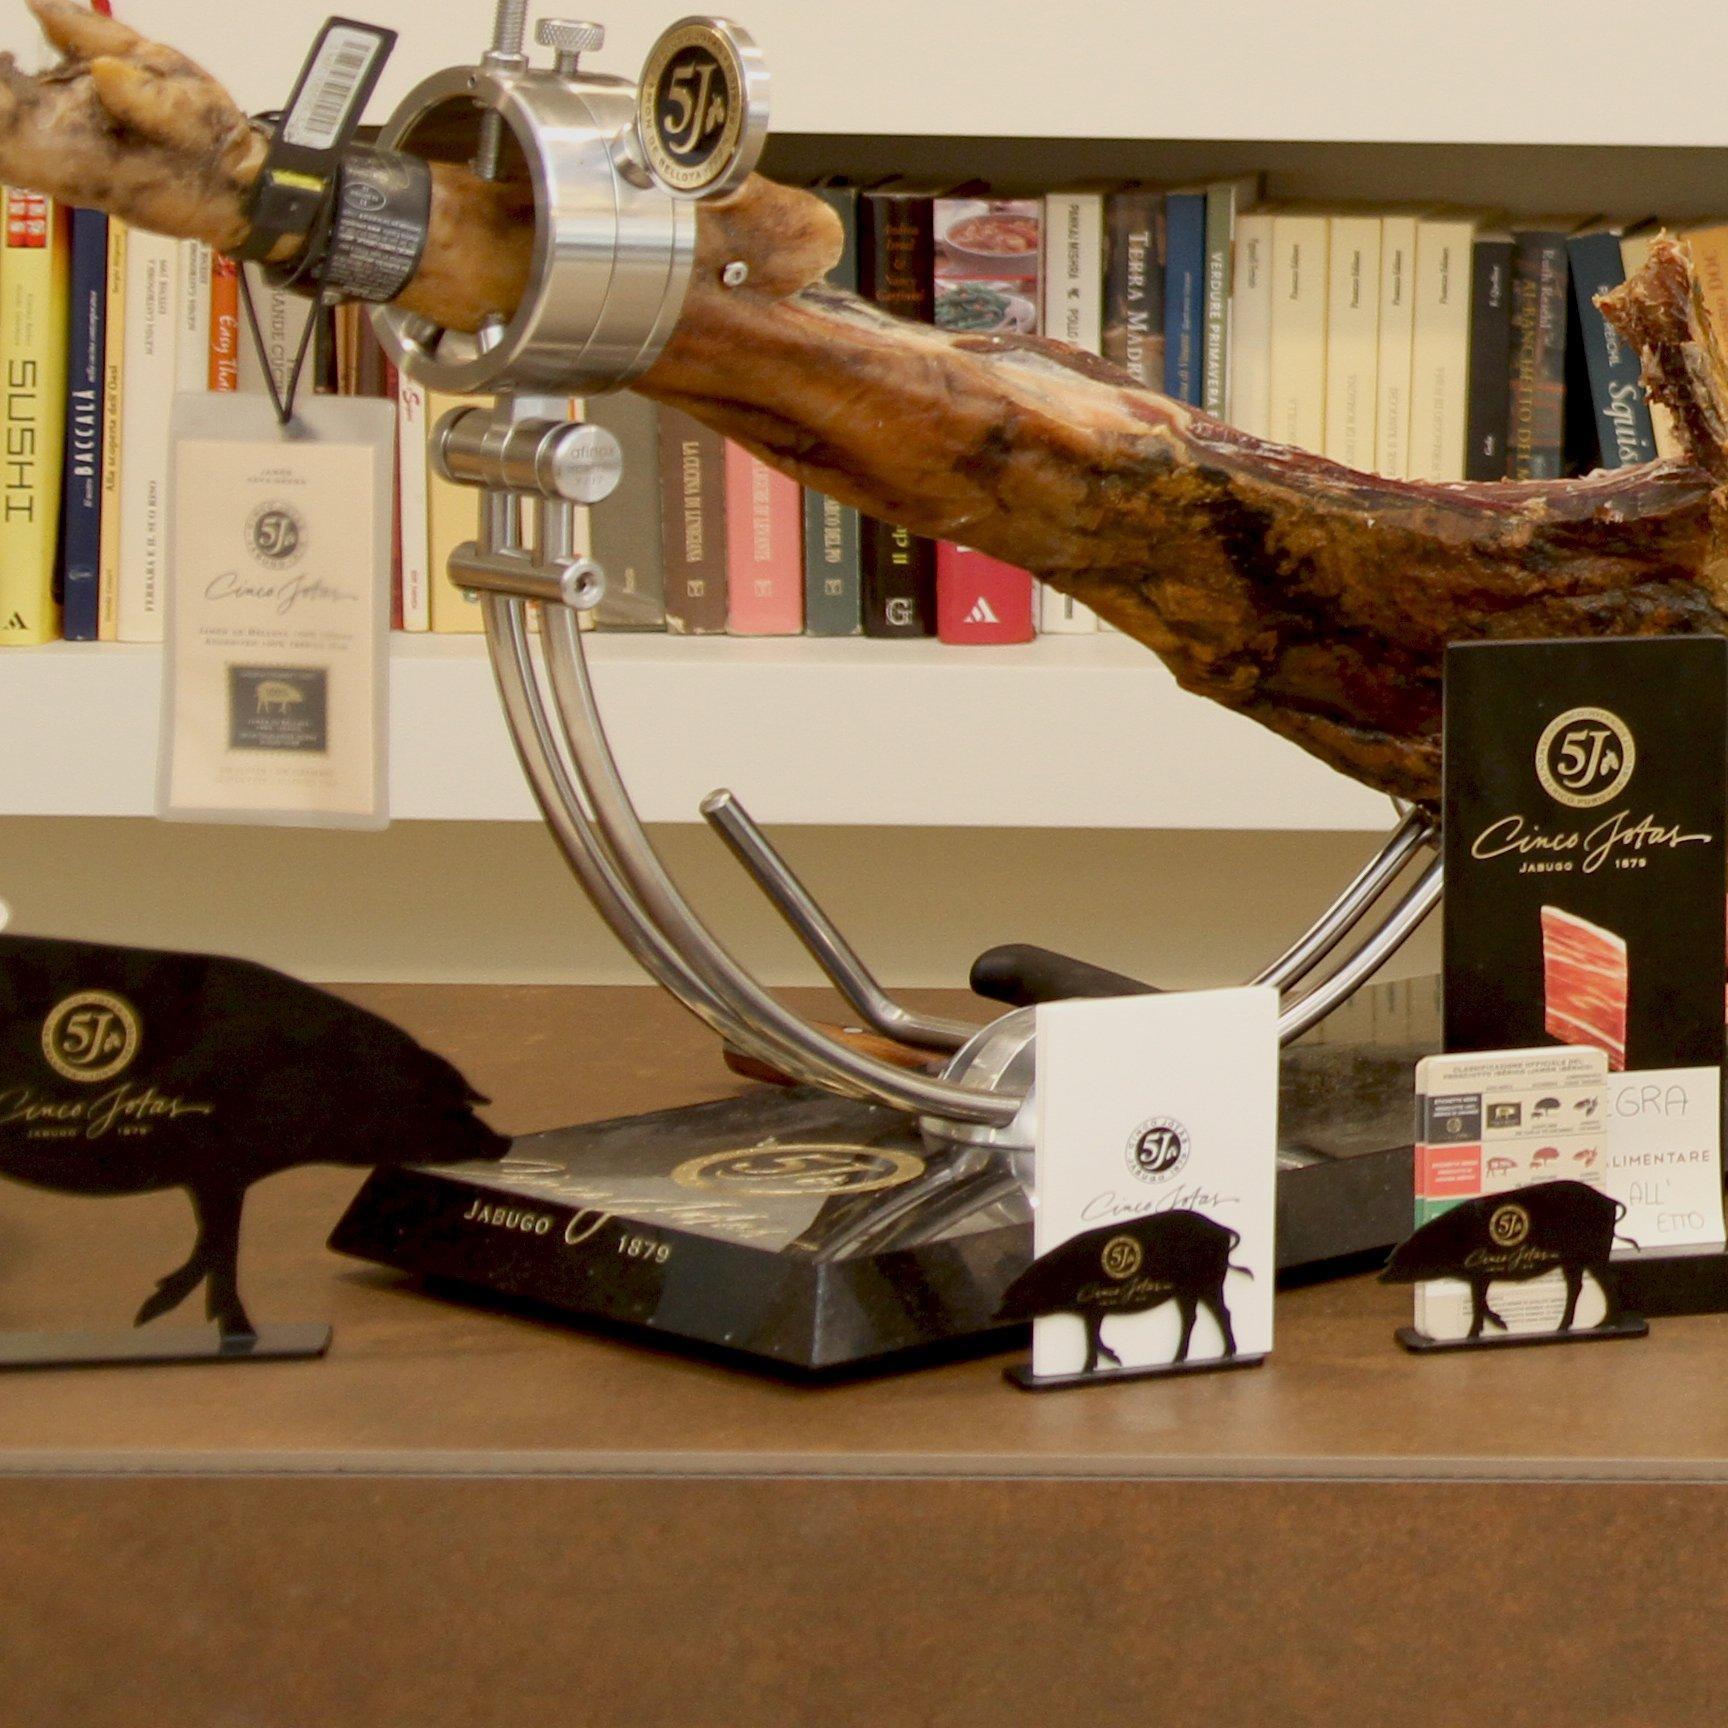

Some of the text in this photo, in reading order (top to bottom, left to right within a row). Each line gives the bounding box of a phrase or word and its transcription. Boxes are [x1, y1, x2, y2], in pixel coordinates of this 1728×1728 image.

[1126, 228, 1151, 302] TERRA
[211, 314, 235, 355] Easy
[1206, 250, 1224, 405] VERDURE PRIMAVERA
[5, 360, 37, 523] SUSHI
[73, 388, 97, 477] BACCALÀ
[204, 571, 276, 602] Cinco
[1557, 728, 1612, 790] 5J
[1471, 809, 1713, 874] Cinco Jotas
[1518, 856, 1648, 875] JABUGO 1879
[63, 1011, 114, 1065] 5J
[87, 1082, 213, 1140] Jotas
[1138, 1132, 1174, 1171] 5J
[1081, 1183, 1240, 1222] Cinco Jotas
[1629, 1179, 1672, 1208] ALL'
[464, 1199, 672, 1265] JABUGO 1879
[1656, 1212, 1705, 1234] ETTO
